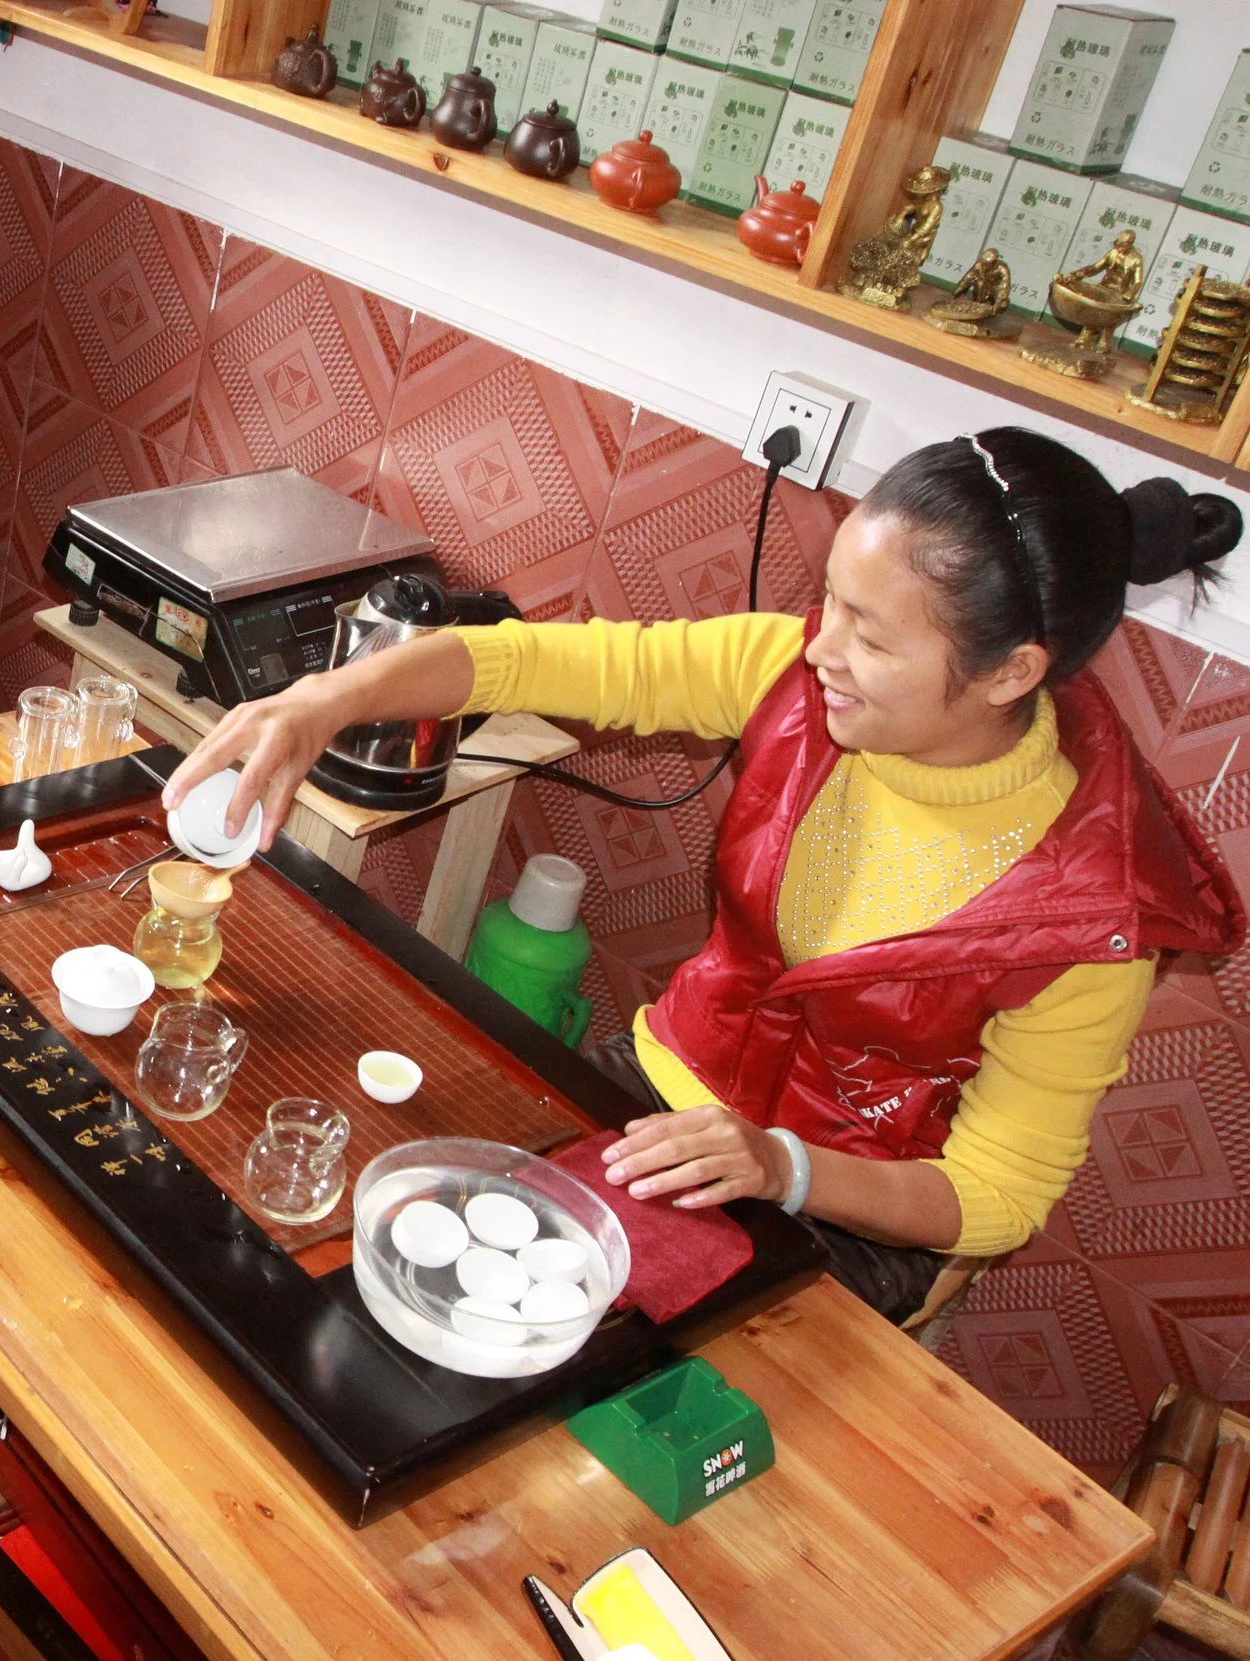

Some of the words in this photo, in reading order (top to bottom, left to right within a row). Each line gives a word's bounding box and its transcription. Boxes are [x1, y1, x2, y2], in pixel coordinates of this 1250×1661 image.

[1200, 183, 1250, 206] 耐熱ガラ
[703, 1440, 743, 1478] SNOW
